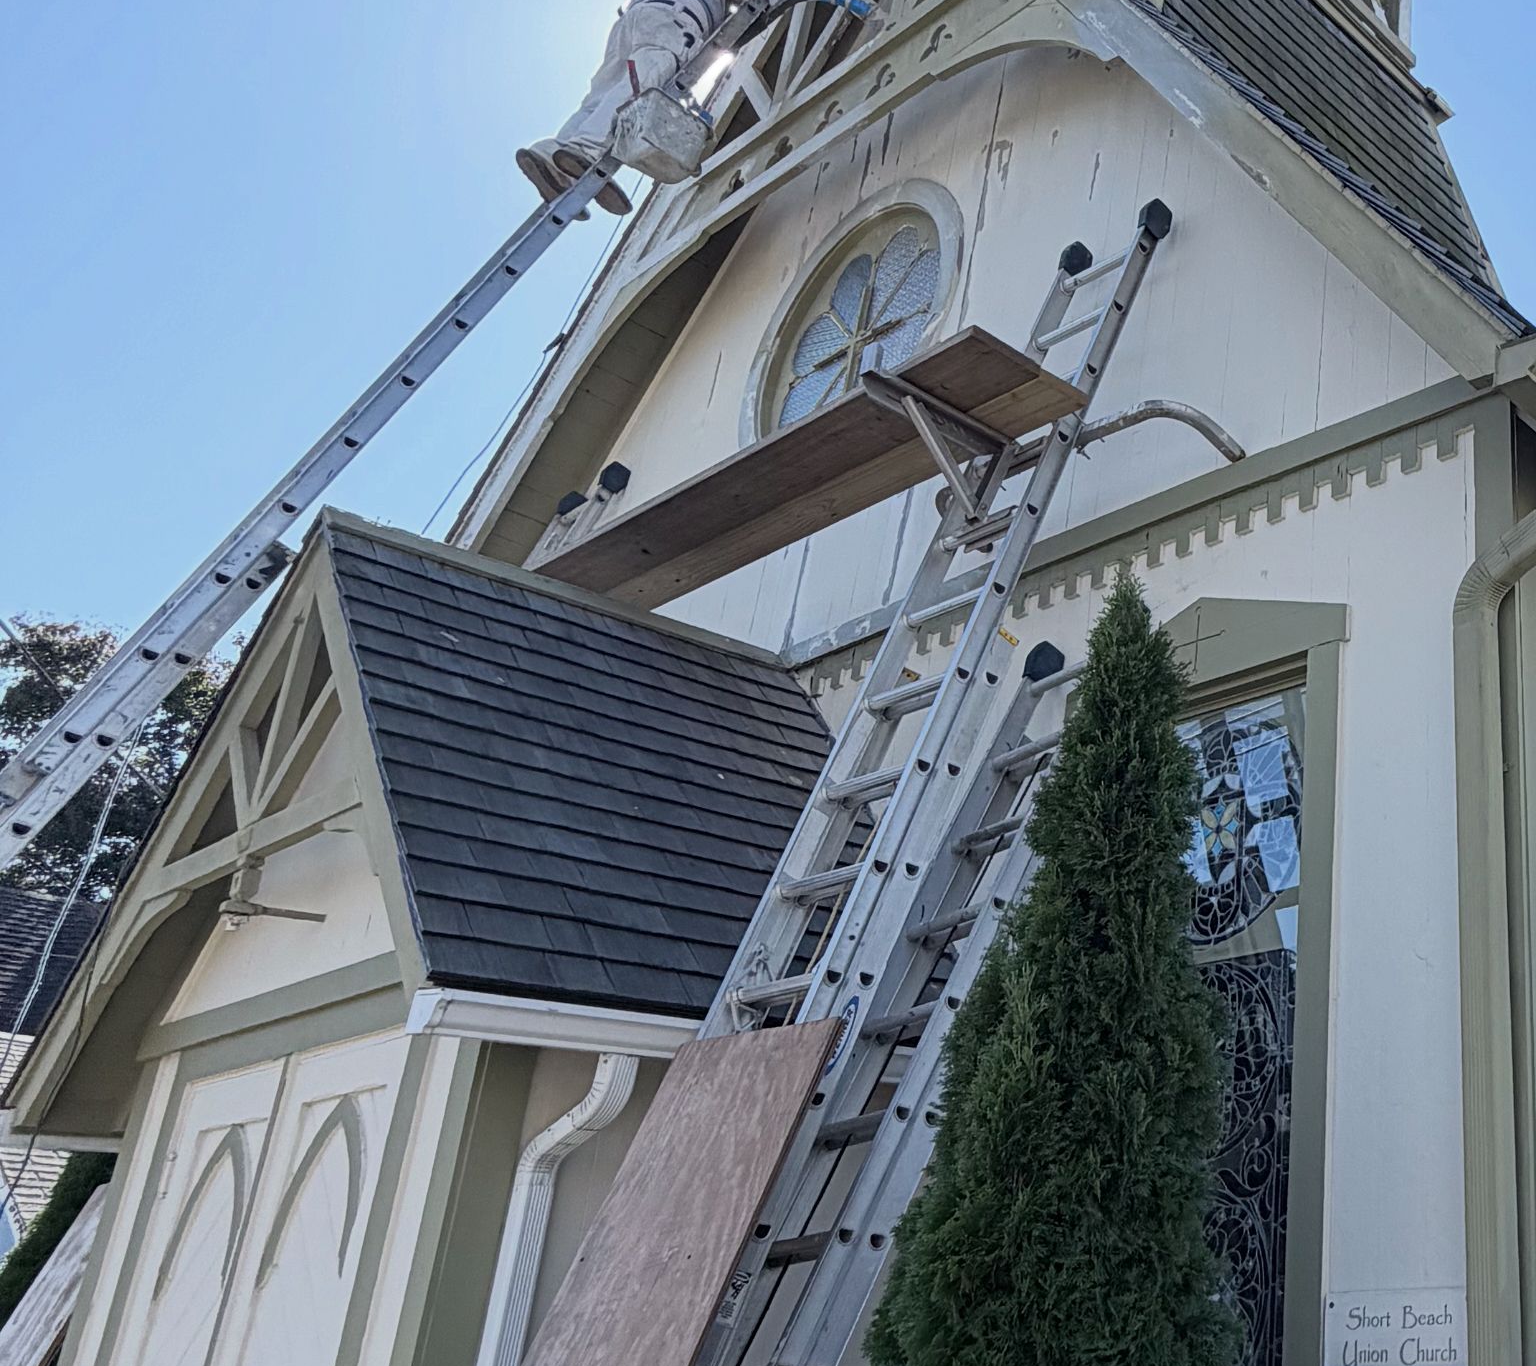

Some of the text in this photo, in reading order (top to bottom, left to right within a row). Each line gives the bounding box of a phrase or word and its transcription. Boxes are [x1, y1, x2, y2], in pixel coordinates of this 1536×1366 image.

[1345, 1303, 1453, 1331] Short Beach
[1400, 1336, 1458, 1366] Church
